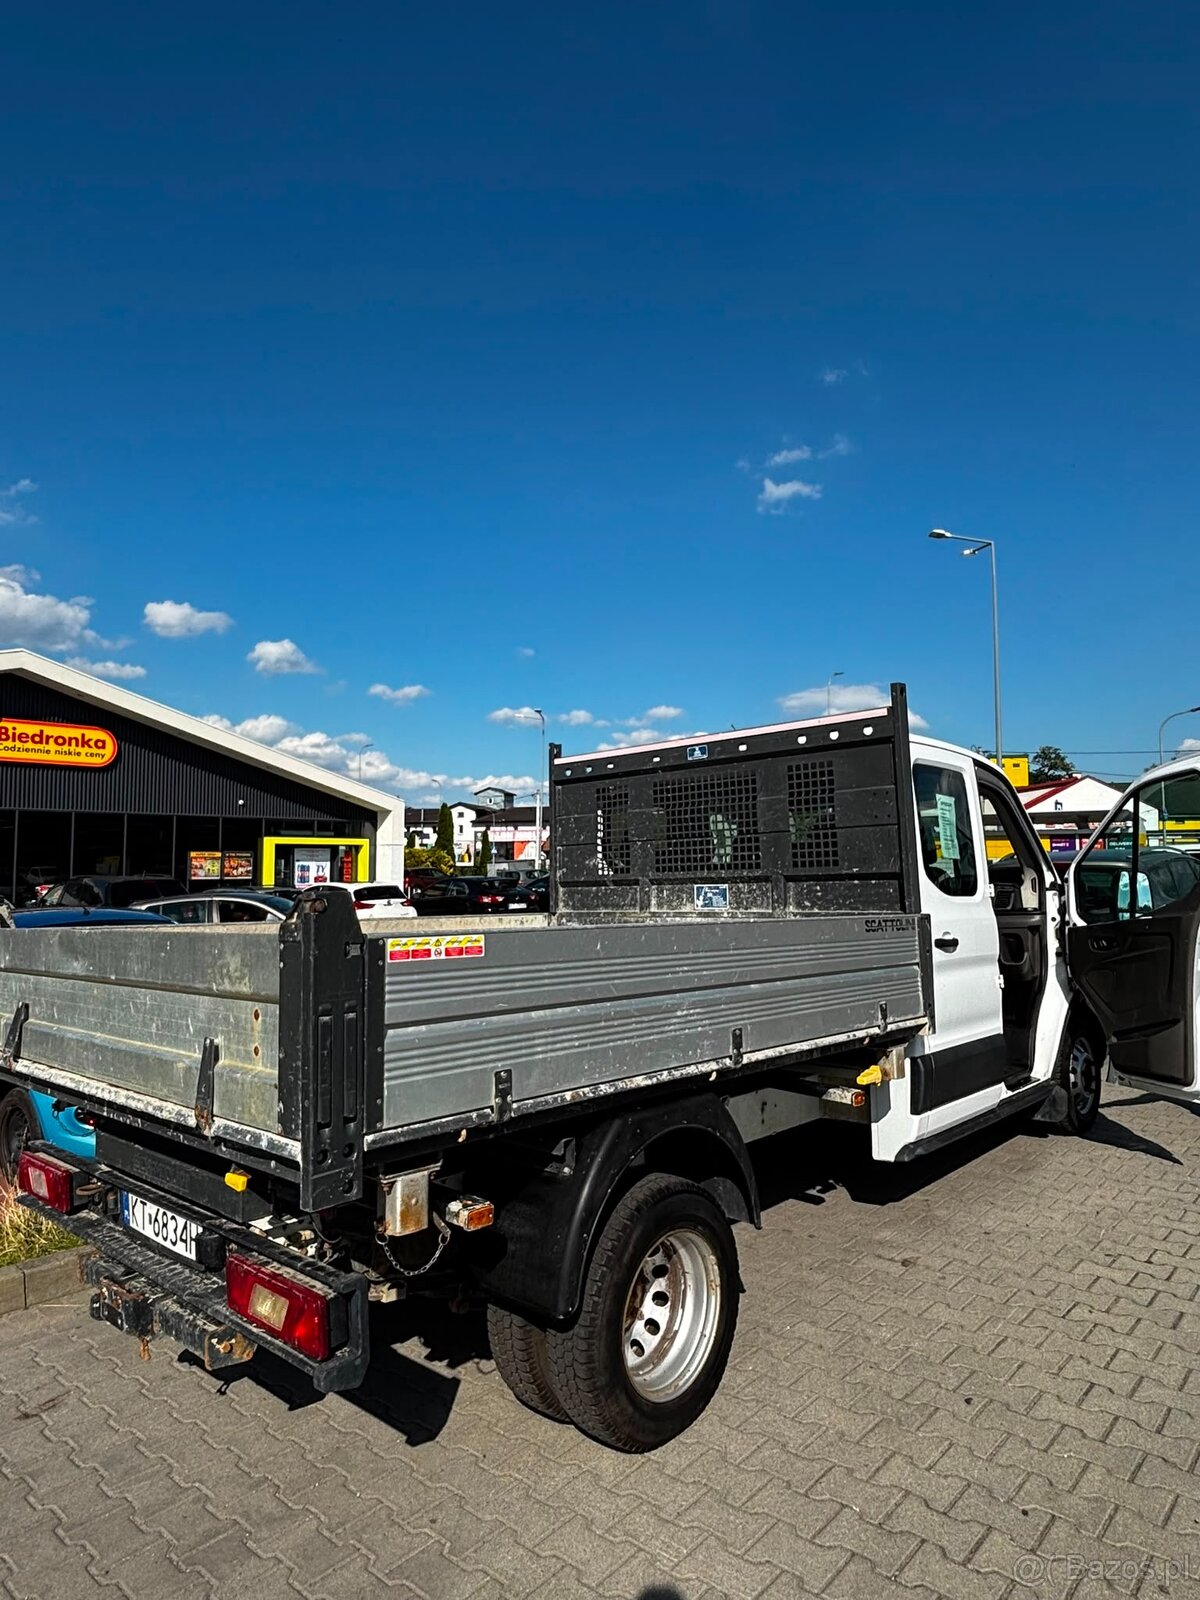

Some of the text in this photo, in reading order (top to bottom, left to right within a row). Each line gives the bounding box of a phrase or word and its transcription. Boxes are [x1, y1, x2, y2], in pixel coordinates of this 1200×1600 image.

[0, 726, 106, 750] Biedronka
[54, 748, 82, 757] niskie
[85, 751, 106, 760] ceny
[131, 1195, 147, 1231] KT
